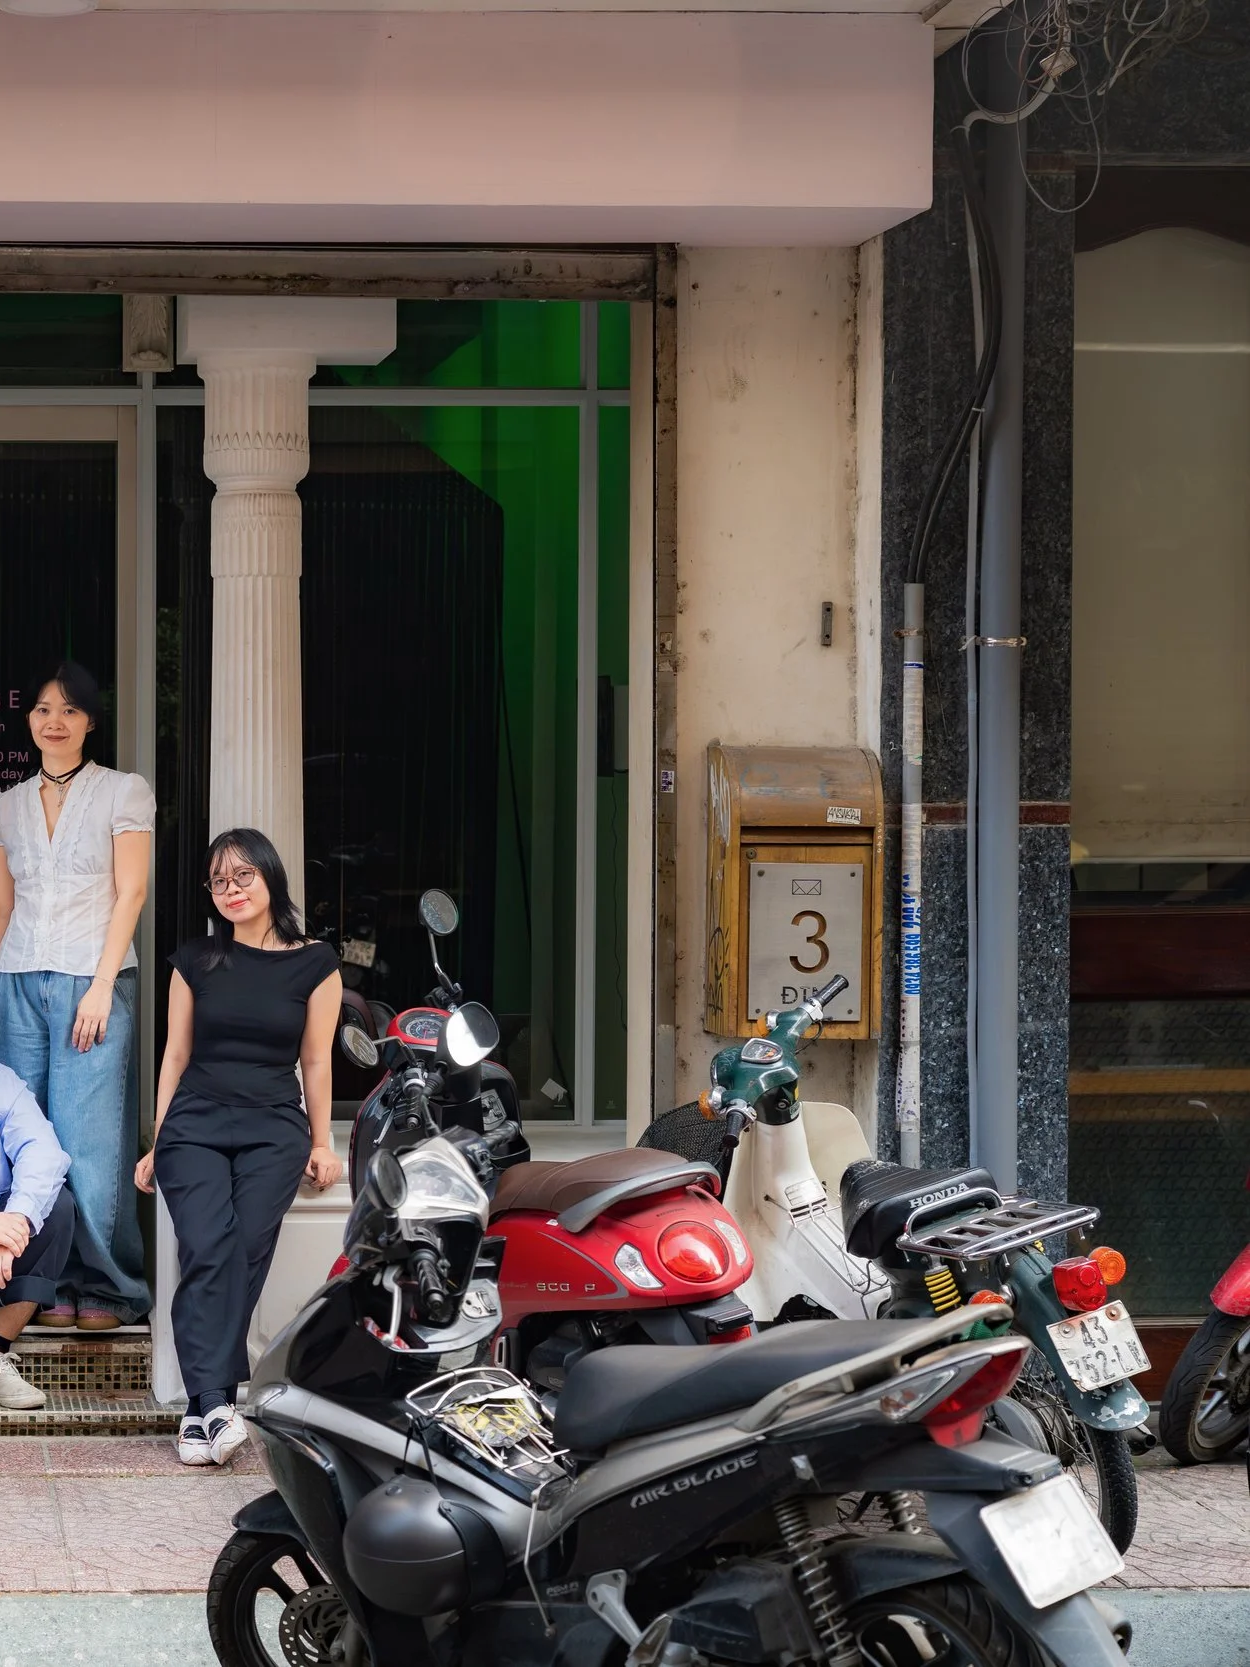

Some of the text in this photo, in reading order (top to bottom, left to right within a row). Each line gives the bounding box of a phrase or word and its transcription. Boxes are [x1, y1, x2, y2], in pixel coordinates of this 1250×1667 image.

[8, 751, 30, 763] PM
[789, 910, 830, 974] 3
[908, 1182, 970, 1209] HONDA
[1079, 1316, 1108, 1348] 43
[630, 1450, 759, 1509] AIR BLADE
